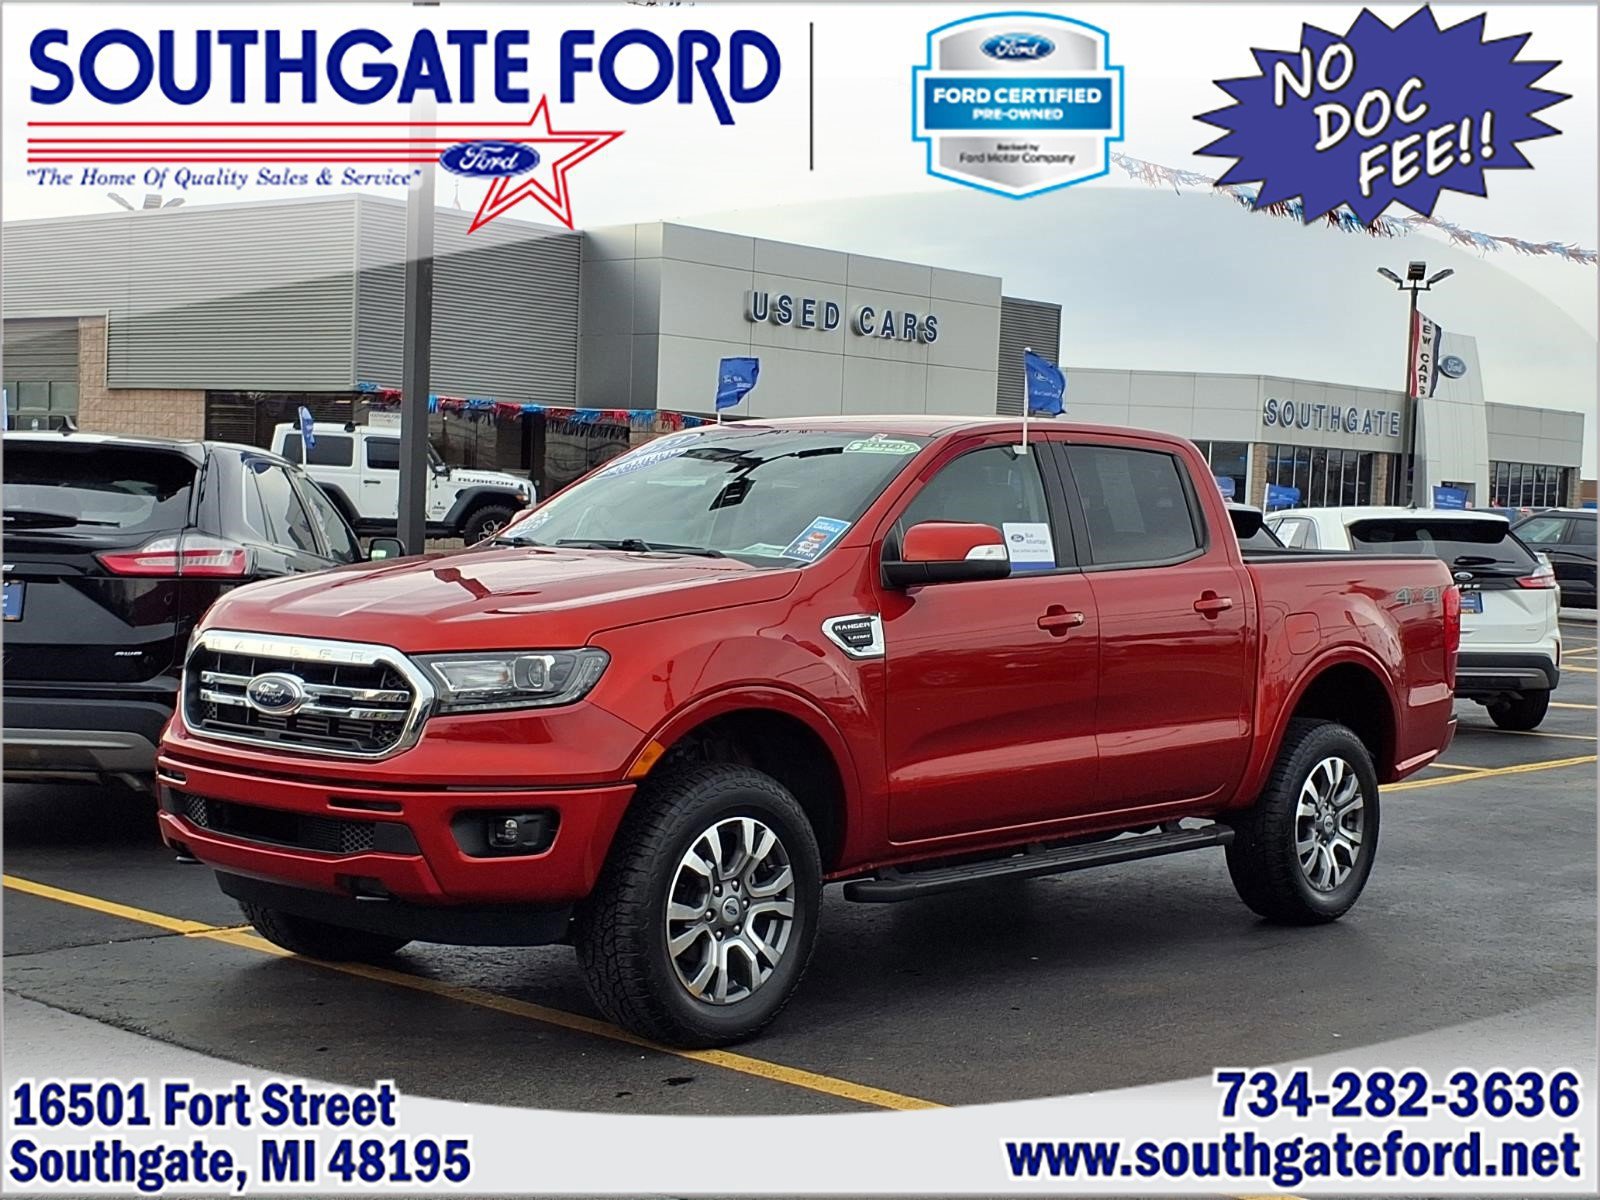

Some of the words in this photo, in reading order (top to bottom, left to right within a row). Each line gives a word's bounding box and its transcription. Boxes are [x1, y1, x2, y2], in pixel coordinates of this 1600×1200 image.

[752, 291, 840, 330] USED
[855, 305, 939, 344] CARS
[1418, 353, 1430, 395] CARS
[1264, 398, 1400, 437] SOUTHGATE
[458, 477, 514, 487] RUBICON
[834, 622, 871, 631] RANGER
